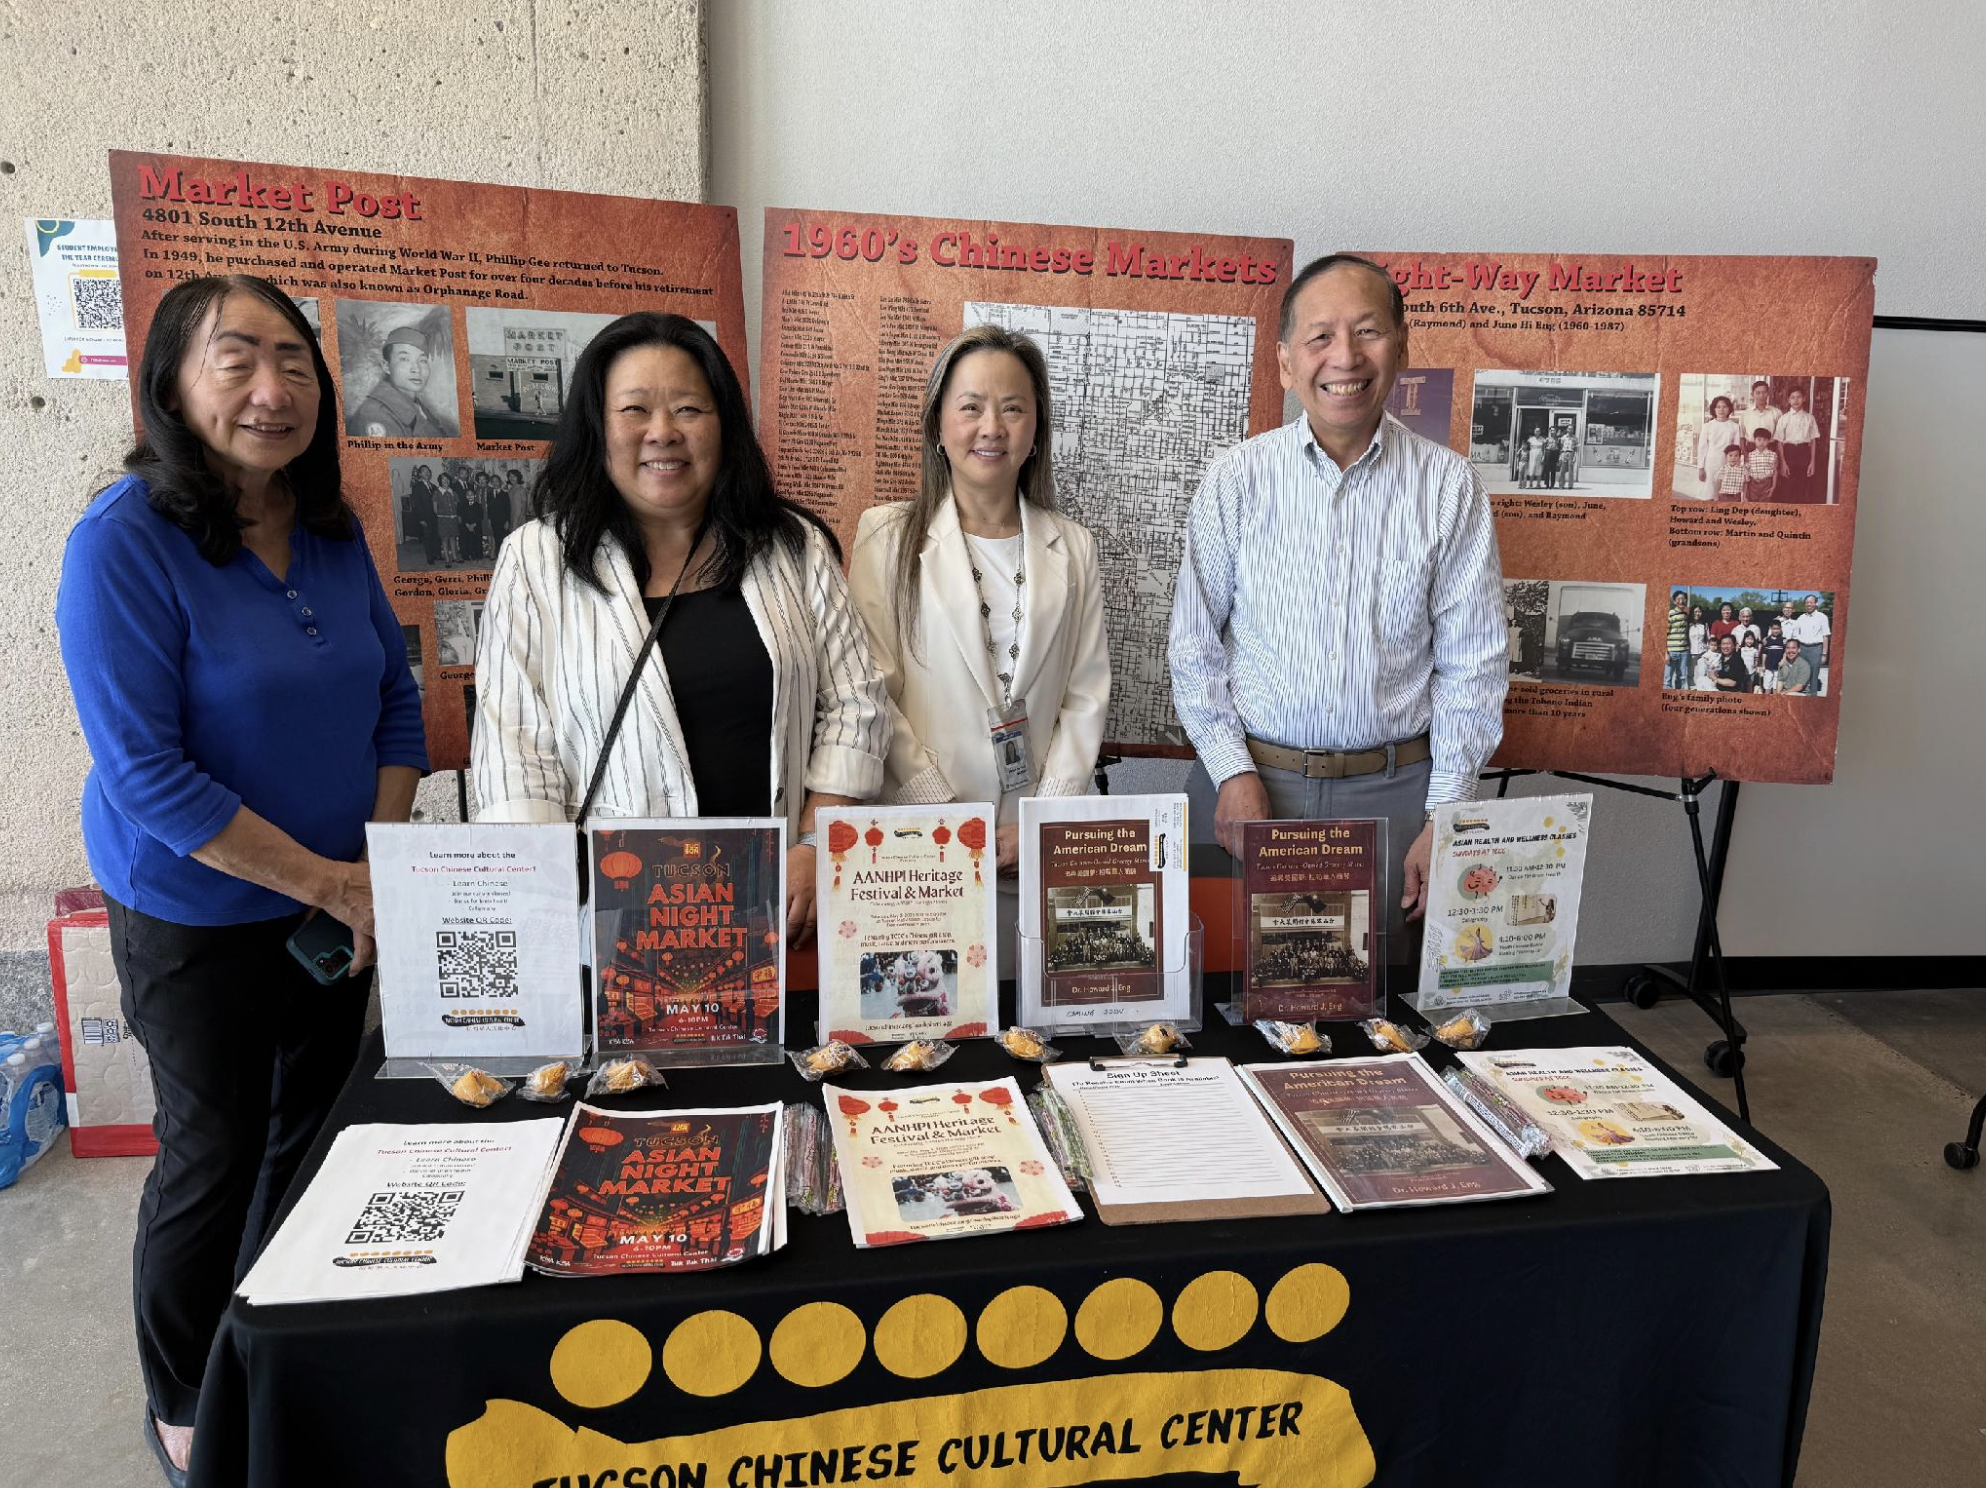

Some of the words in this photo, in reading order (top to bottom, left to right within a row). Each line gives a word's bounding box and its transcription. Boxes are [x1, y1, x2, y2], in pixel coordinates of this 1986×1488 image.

[138, 164, 314, 212] Market
[324, 179, 422, 221] Post
[142, 208, 192, 224] 4801
[200, 211, 257, 229] South
[263, 216, 309, 233] 12th
[313, 219, 382, 239] Avenue
[141, 230, 179, 242] After
[183, 233, 236, 249] serving
[240, 236, 253, 247] in
[256, 237, 280, 249] the
[283, 239, 310, 251] U.S.
[314, 241, 348, 256] Army
[352, 244, 396, 260] during
[399, 247, 438, 260] World
[440, 251, 466, 261] War
[469, 252, 483, 264] II,
[486, 253, 526, 267] Phillip
[528, 257, 551, 268] Gee
[552, 259, 605, 271] returned
[607, 262, 619, 272] to
[621, 263, 664, 276] Tucson.
[929, 231, 1094, 274] Chinese
[1106, 242, 1277, 284] Markets
[143, 249, 159, 260] In
[162, 250, 203, 264] 1949,
[206, 253, 223, 264] he
[226, 255, 297, 269] purchased
[300, 260, 325, 270] and
[328, 261, 387, 276] operated
[390, 264, 437, 277] Market
[439, 268, 466, 279] Post
[469, 270, 488, 280] for
[490, 272, 517, 282] over
[520, 274, 546, 285] four
[548, 276, 593, 288] decades
[595, 279, 633, 290] before
[635, 281, 651, 291] his
[653, 283, 714, 296] retirement
[1386, 259, 1540, 299] ght-Way
[1549, 262, 1683, 292] Market
[145, 270, 163, 278] on
[167, 269, 198, 280] 12th
[301, 279, 327, 289] was
[330, 279, 356, 290] also
[359, 281, 403, 293] known
[407, 285, 421, 294] as
[423, 284, 492, 300] Orphanage
[494, 289, 528, 300] Road.
[1403, 301, 1435, 314] outh
[1439, 301, 1465, 314] 6th
[1469, 302, 1505, 316] Ave.,
[1510, 302, 1567, 317] Tucson,
[1573, 304, 1633, 316] Arizona
[1637, 304, 1685, 317] 85714
[1409, 319, 1466, 331] (Raymond)
[1470, 320, 1489, 329] and
[1492, 320, 1517, 329] June
[1521, 320, 1532, 329] Hi
[1536, 321, 1555, 332] Eng
[1559, 320, 1625, 332] (1960-1987)
[347, 440, 382, 451] Phillip
[384, 441, 395, 450] in
[396, 441, 414, 450] the
[416, 441, 444, 452] Army
[476, 442, 512, 451] Market
[515, 443, 536, 451] Post
[1524, 500, 1553, 509] Wesley
[1582, 501, 1606, 510] June,
[1671, 504, 1687, 513] Top
[1711, 506, 1730, 515] Ling
[1732, 507, 1749, 516] Dep
[1528, 511, 1544, 519] and
[1546, 511, 1587, 521] Raymond
[1669, 527, 1701, 535] Bottom
[1725, 529, 1756, 537] Martin
[1777, 531, 1811, 539] Quintin
[1669, 539, 1720, 548] (grandsons)
[393, 575, 433, 586] George,
[395, 588, 435, 598] Gordon,
[1540, 688, 1578, 696] groceries
[1581, 688, 1590, 696] in
[1687, 694, 1716, 704] family
[1717, 696, 1742, 704] photo
[1529, 708, 1548, 716] than
[1661, 703, 1683, 712] (four
[1685, 706, 1737, 714] generations
[1739, 708, 1771, 716] shown)
[1065, 829, 1114, 841] Pursuing
[1117, 828, 1135, 837] the
[1271, 828, 1326, 842] Pursuing
[1330, 827, 1350, 838] the
[1453, 838, 1473, 847] ASIAN
[1474, 836, 1500, 845] HEALTH
[1053, 844, 1107, 855] American
[1110, 843, 1147, 852] Dream
[1259, 844, 1318, 857] American
[1322, 844, 1363, 854] Dream
[652, 863, 730, 878] TUCSON
[853, 870, 906, 884] AANHPI
[909, 868, 962, 884] Heritage
[647, 883, 734, 904] ASIAN
[851, 886, 902, 901] Festival
[904, 886, 916, 899] &
[918, 885, 964, 899] Market
[650, 905, 734, 927] NIGHT
[636, 928, 747, 950] MARKET
[666, 1004, 699, 1015] MAY
[704, 1003, 720, 1013] 10
[1289, 1070, 1356, 1079] Pursuing
[1284, 1079, 1354, 1090] American
[1356, 1077, 1406, 1086] Dream
[872, 1121, 931, 1135] AANHPI
[934, 1117, 995, 1129] Heritage
[870, 1132, 929, 1145] Festival
[932, 1131, 944, 1139] &
[947, 1125, 1001, 1138] Market
[621, 1147, 721, 1164] ASIAN
[620, 1162, 719, 1179] NIGHT
[599, 1176, 731, 1196] MARKET
[620, 1234, 663, 1245] MAY
[669, 1233, 688, 1243] 10
[727, 1440, 920, 1488] CHINESE
[937, 1417, 1141, 1475] CULTURAL
[1160, 1401, 1303, 1450] CENTER
